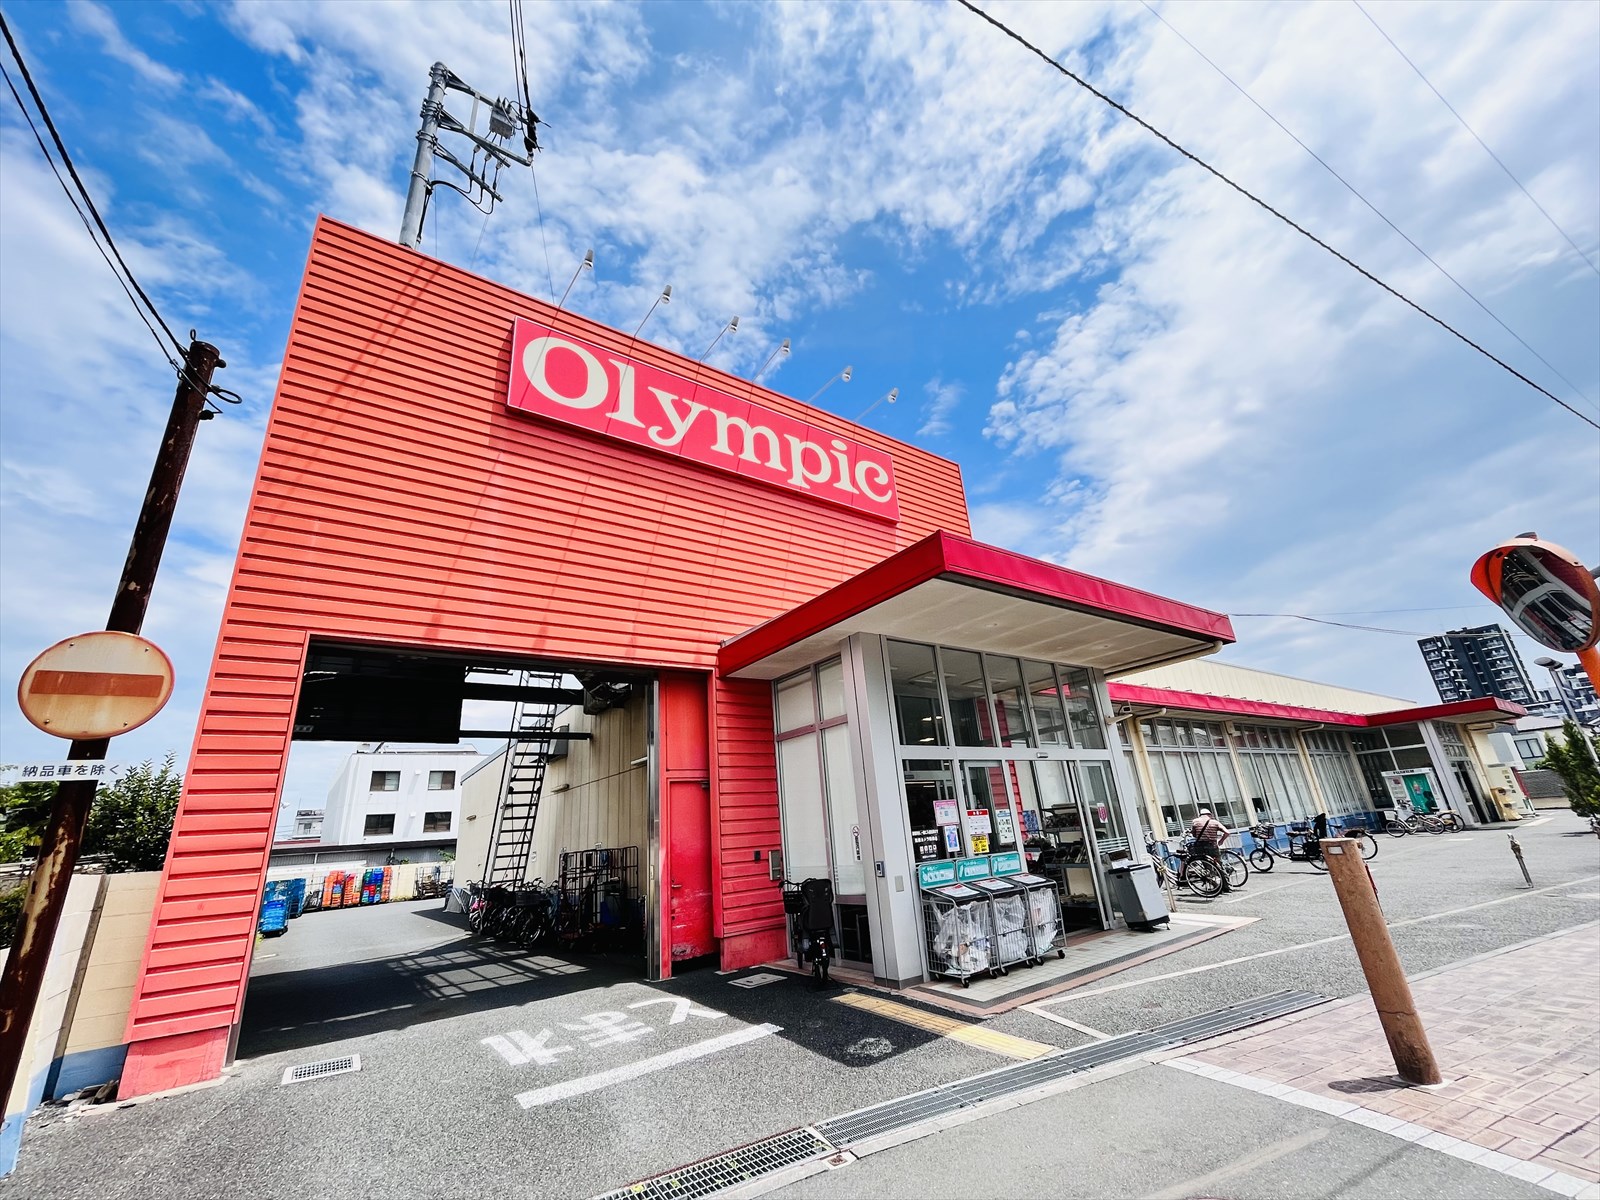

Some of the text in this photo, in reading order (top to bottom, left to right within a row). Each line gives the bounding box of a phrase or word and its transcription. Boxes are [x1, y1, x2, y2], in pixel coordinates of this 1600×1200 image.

[523, 337, 892, 503] Olympic
[22, 764, 120, 777] 納品車を除く
